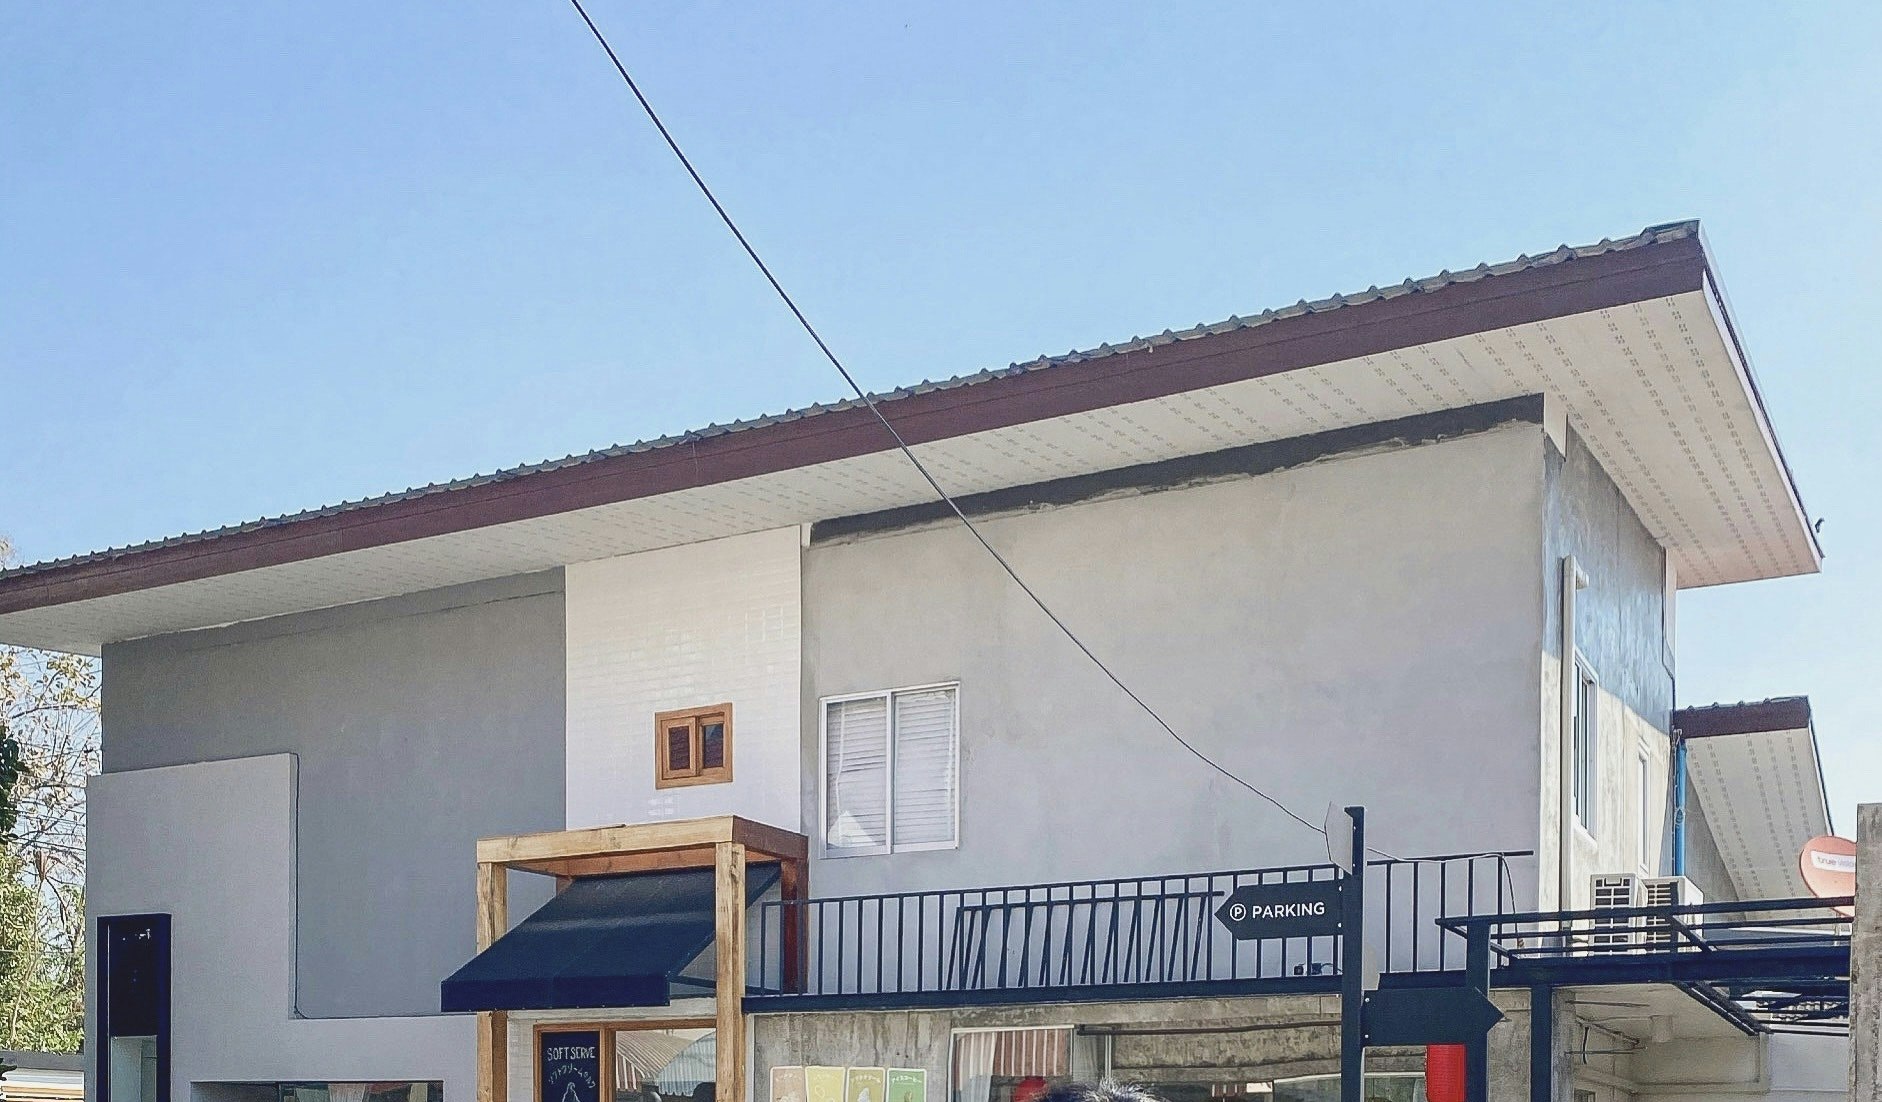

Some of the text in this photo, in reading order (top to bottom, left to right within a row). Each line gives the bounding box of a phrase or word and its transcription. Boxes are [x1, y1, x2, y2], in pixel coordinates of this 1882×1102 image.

[1252, 901, 1325, 918] PARKING
[547, 1046, 596, 1061] SOFT SERVE
